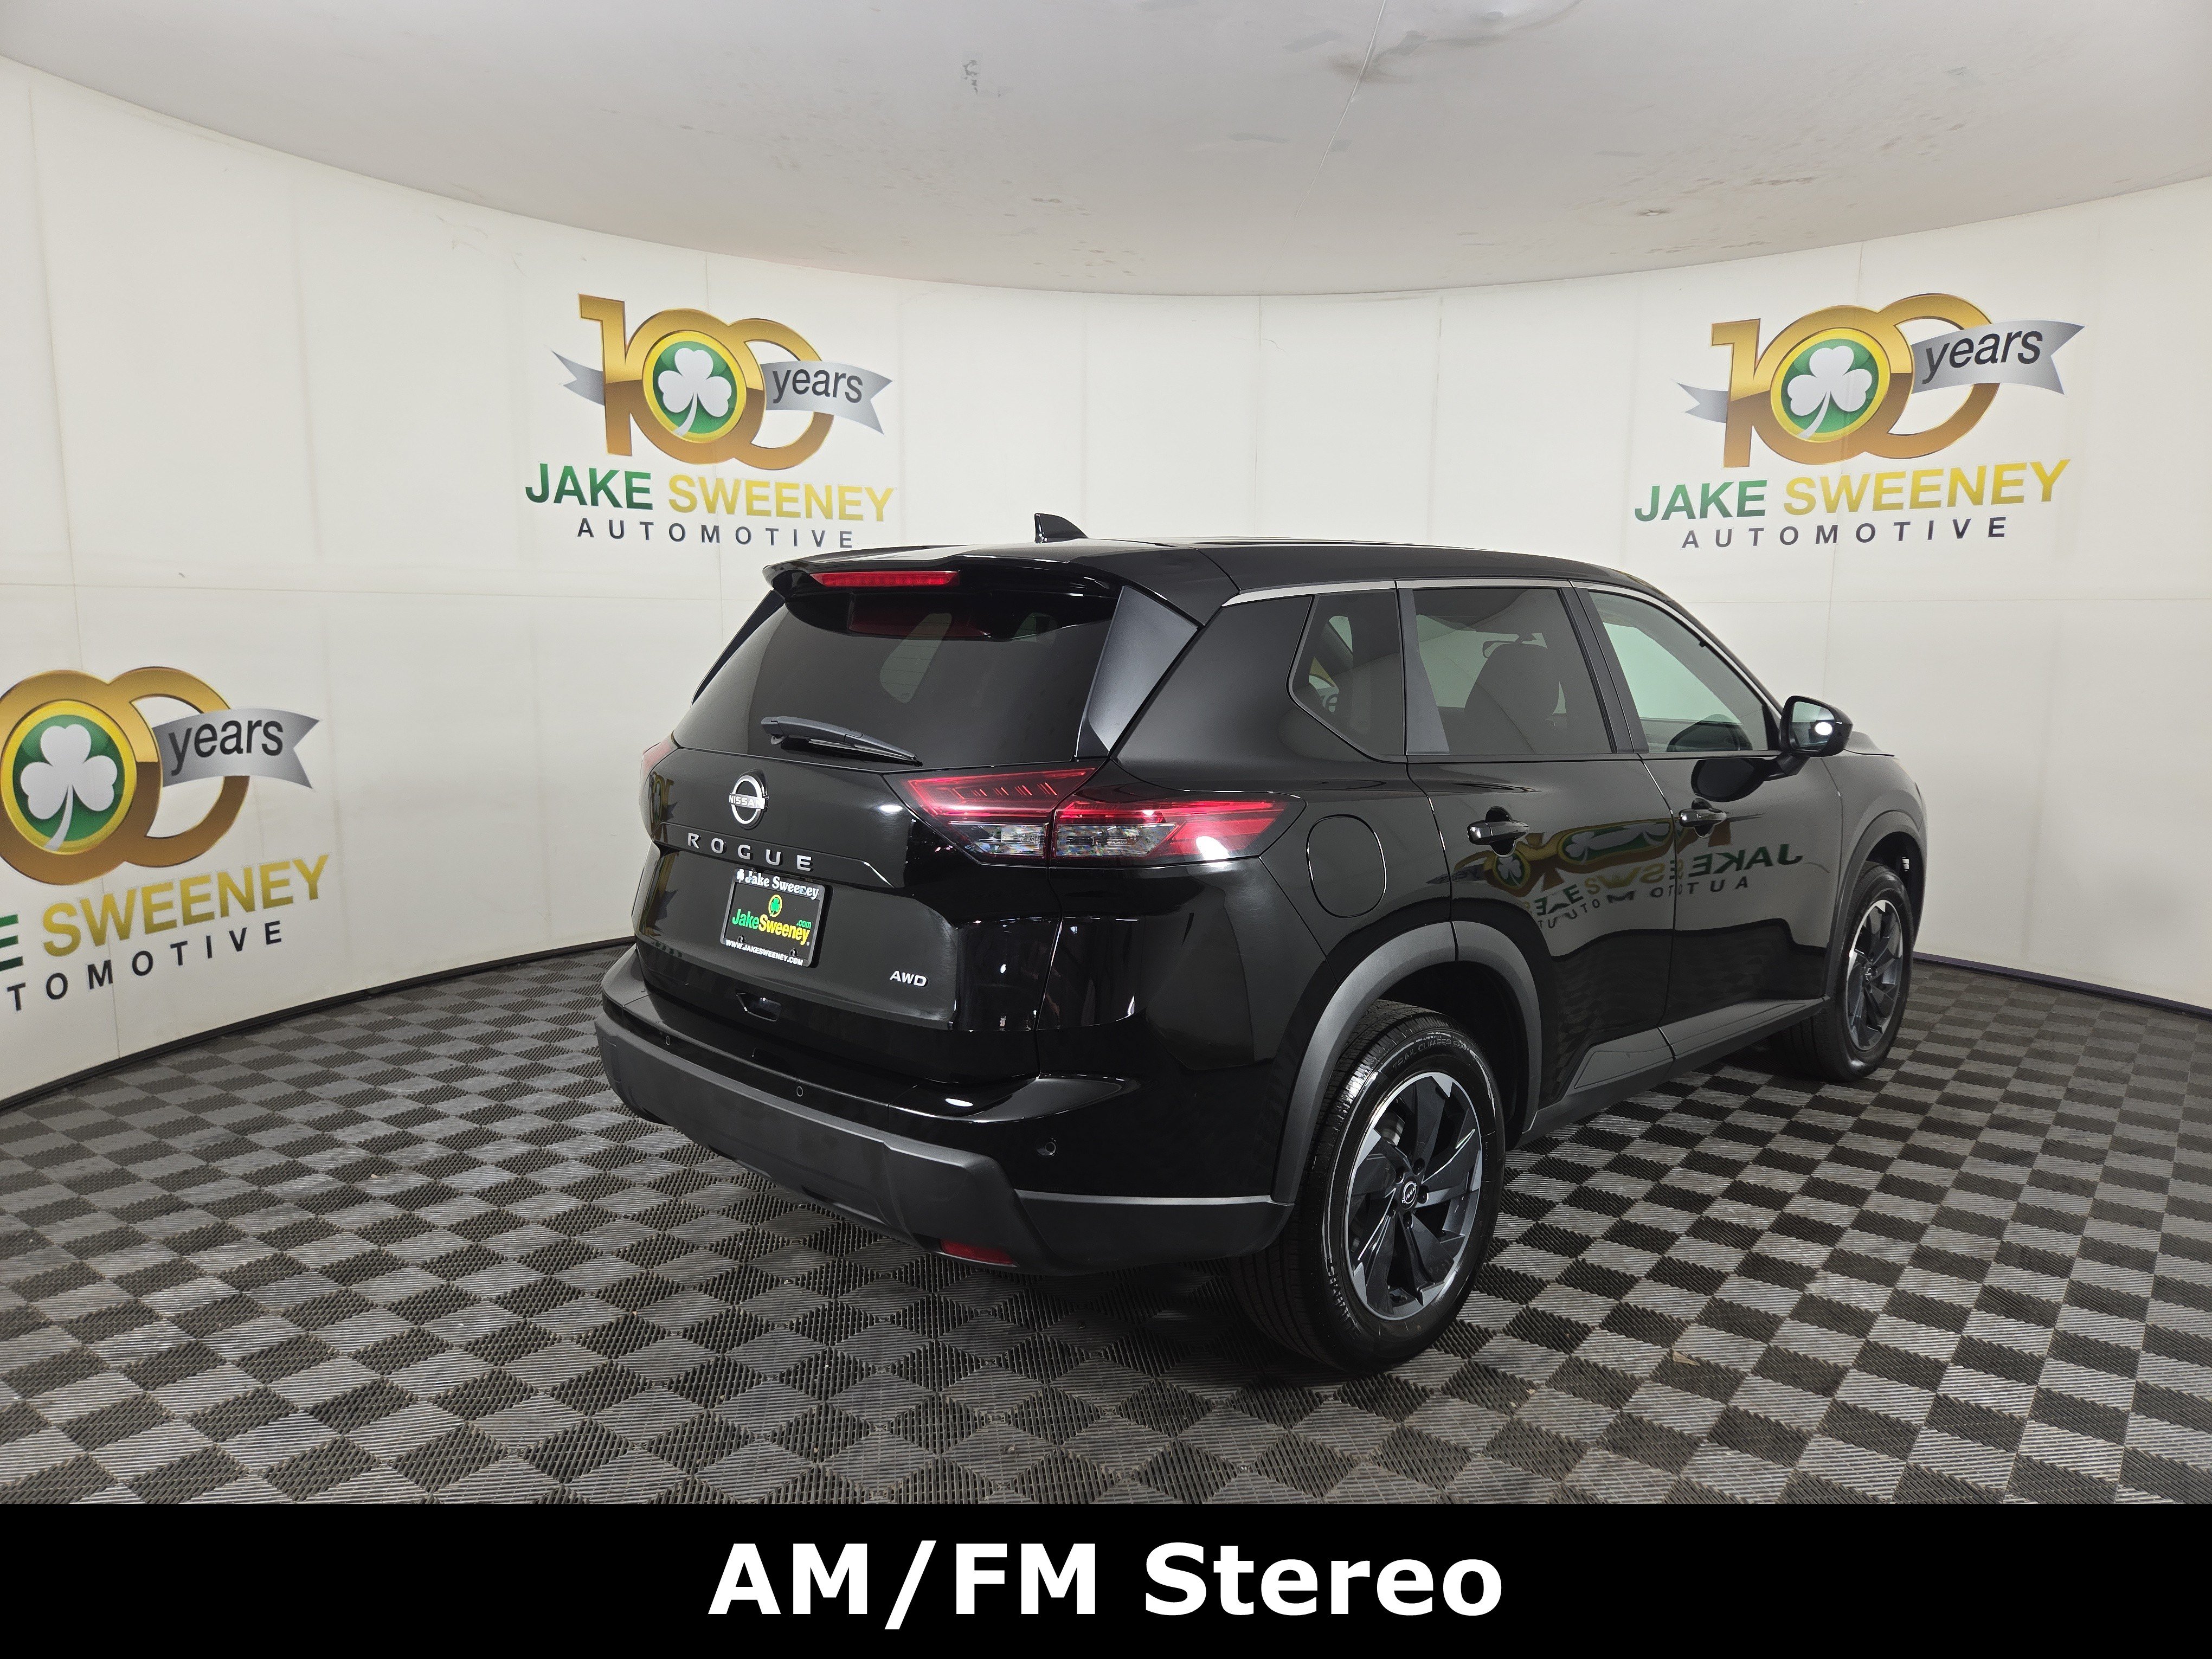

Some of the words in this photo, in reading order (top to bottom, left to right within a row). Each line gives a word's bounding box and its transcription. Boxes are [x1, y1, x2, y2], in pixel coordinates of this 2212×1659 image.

[1921, 330, 2043, 384] years
[773, 368, 863, 404] years
[525, 463, 653, 510] JAKE
[668, 474, 895, 523] SWEENEY
[1635, 480, 1767, 522] JAKE
[1783, 459, 2070, 515] SWEENEY
[577, 518, 853, 548] AUTOMOTIVE
[1681, 517, 2007, 549] AUTOMOTIVE
[168, 719, 284, 776] years
[729, 794, 766, 809] NISSAN
[687, 832, 812, 872] ROGUE
[745, 870, 770, 886] Jake
[42, 854, 329, 957] SWEENEY
[7, 920, 282, 1011] TOMOTIVE
[725, 938, 804, 966] WWW.JAKESWEENEY.COM
[890, 970, 927, 987] AWD
